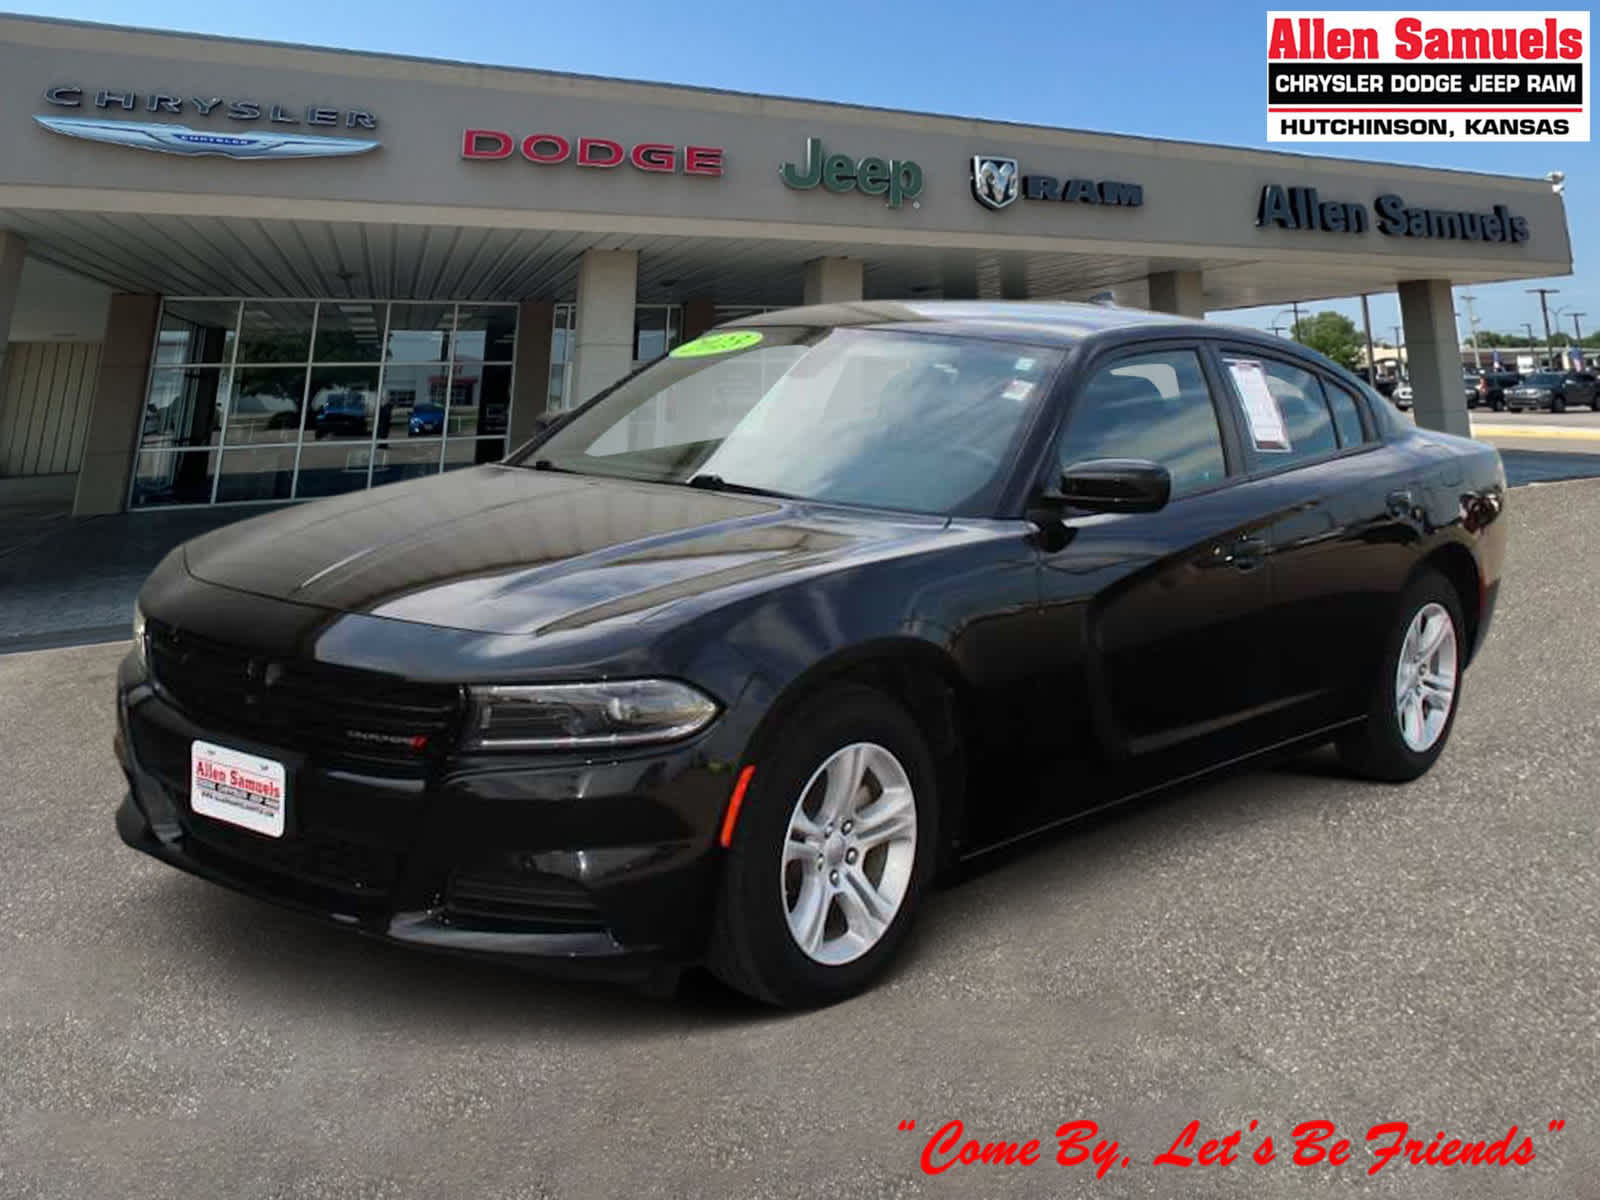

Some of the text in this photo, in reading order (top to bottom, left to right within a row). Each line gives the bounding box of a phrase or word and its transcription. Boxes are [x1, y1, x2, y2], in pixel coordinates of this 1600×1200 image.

[43, 85, 379, 129] CHRYSLER
[461, 128, 725, 176] DODGE
[778, 137, 923, 209] Jeep
[1023, 175, 1144, 207] RAM
[1255, 183, 1531, 243] Allen Samuels
[195, 760, 226, 782] Allen
[229, 769, 281, 798] Samuels
